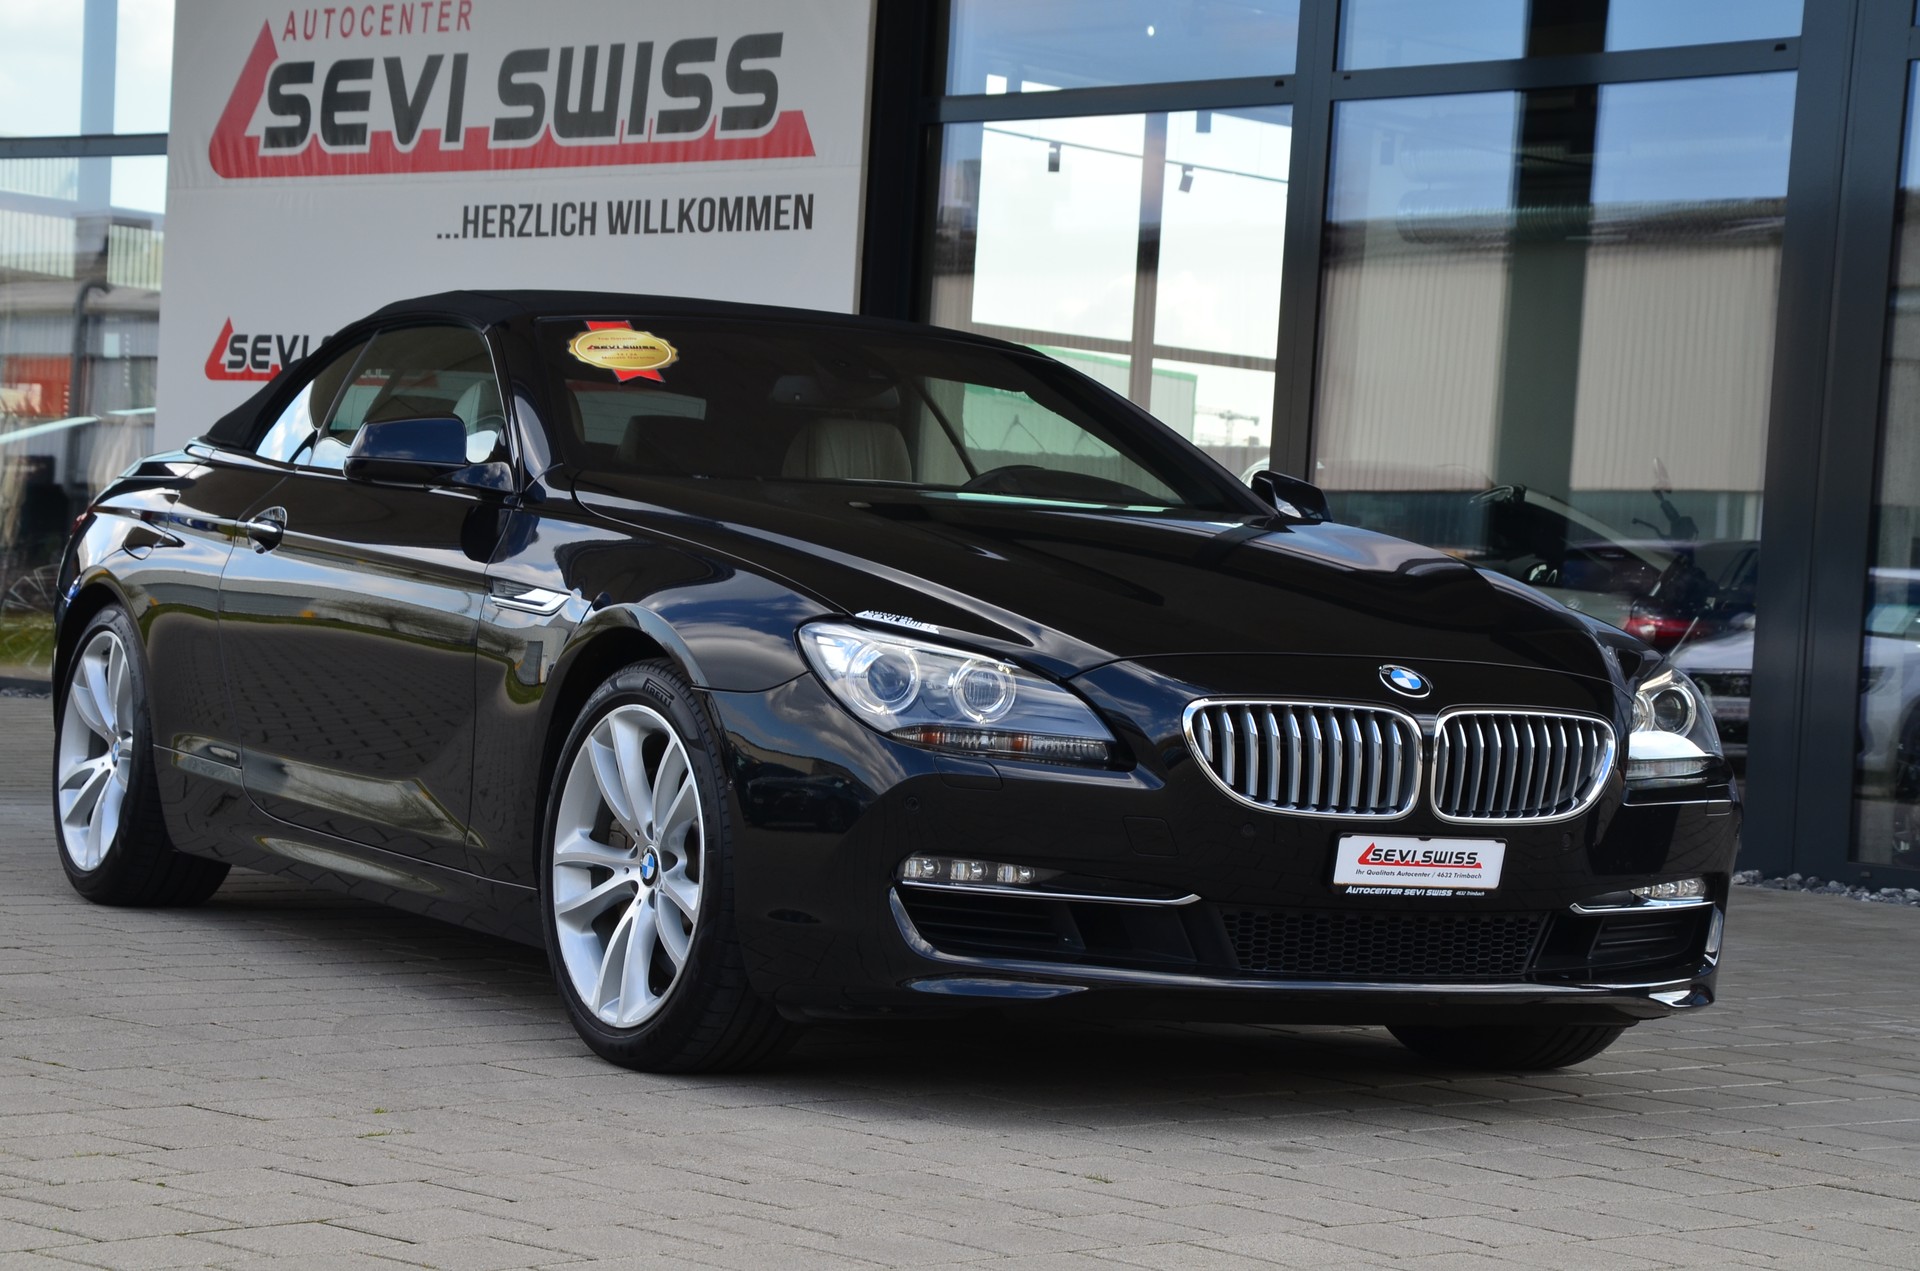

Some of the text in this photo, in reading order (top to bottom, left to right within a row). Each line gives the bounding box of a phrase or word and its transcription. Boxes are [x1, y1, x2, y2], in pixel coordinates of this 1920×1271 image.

[282, 0, 473, 42] AUTOCENTER
[262, 32, 784, 150] SEVI SWISS
[607, 194, 815, 236] WILLKOMMEN
[227, 334, 310, 370] SEVI
[642, 677, 675, 709] PIRELLI
[1370, 848, 1479, 865] SEVI SWISS
[1396, 870, 1431, 878] Autocenter
[1436, 871, 1452, 879] 4632
[1453, 872, 1482, 880] Trimbach
[1403, 887, 1425, 897] SEVI
[1425, 889, 1453, 897] SWISS
